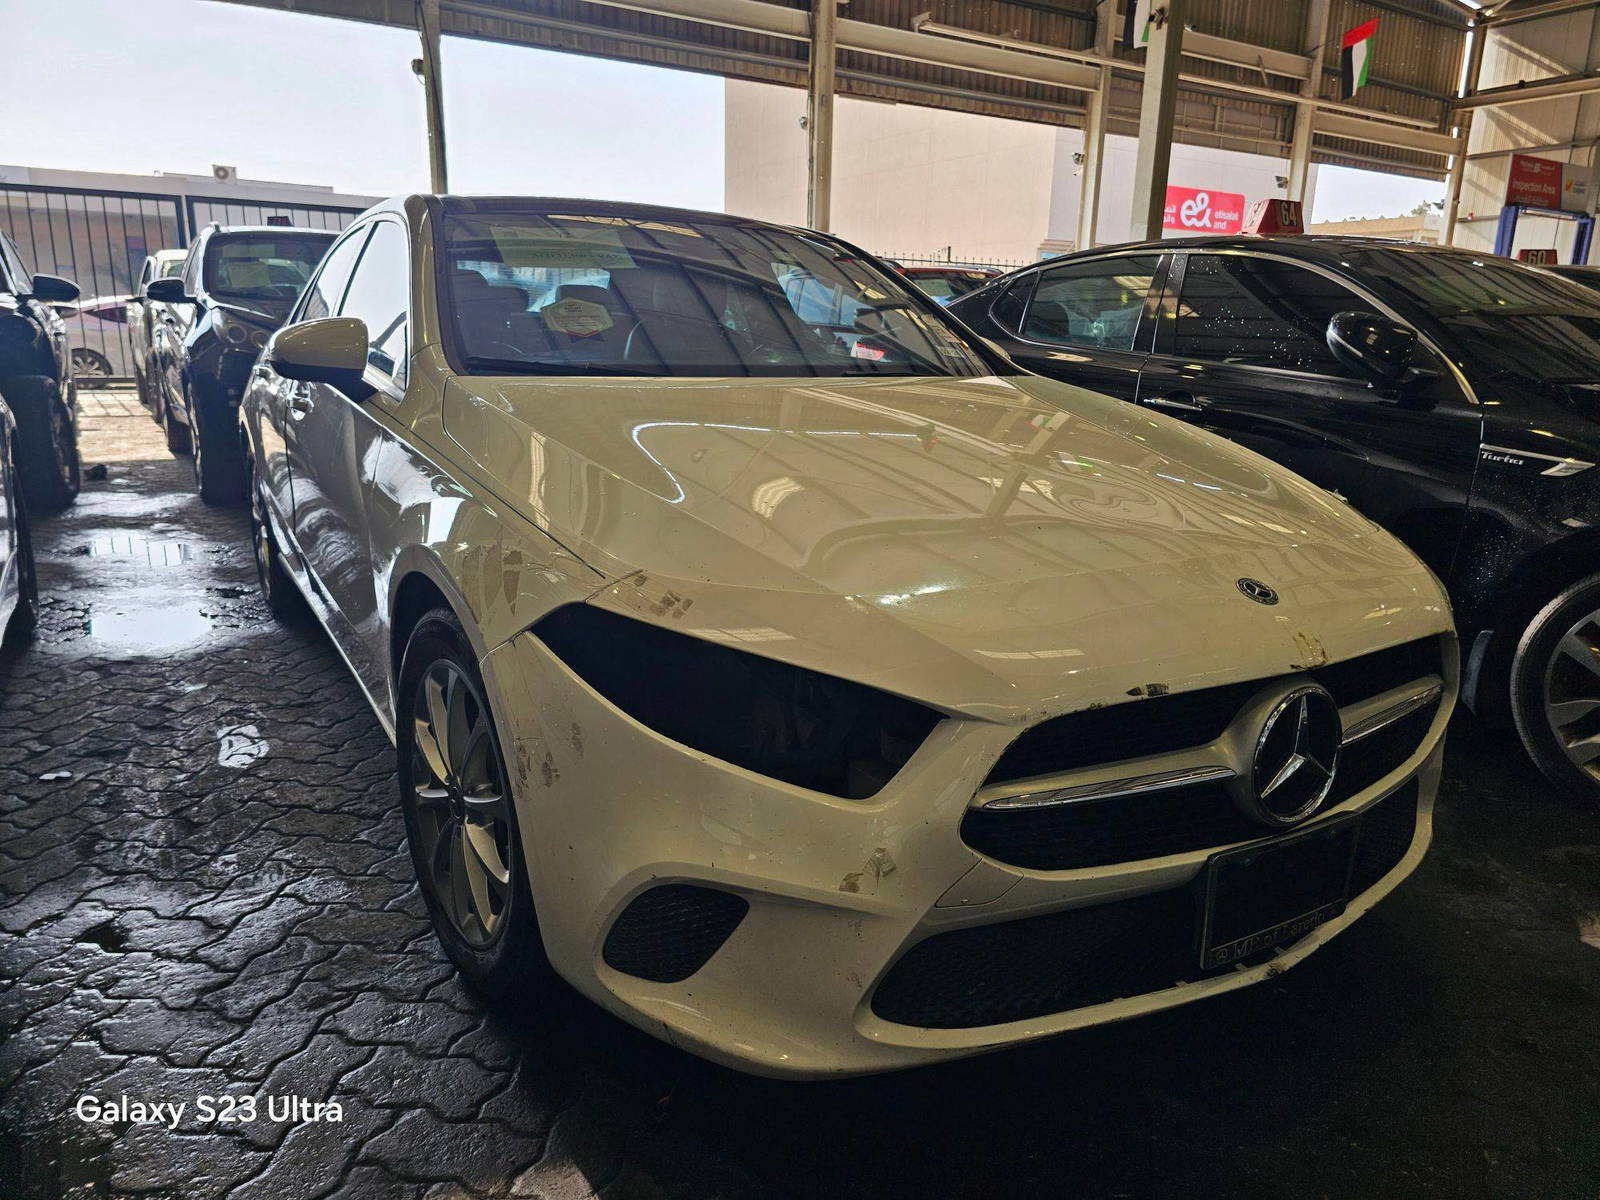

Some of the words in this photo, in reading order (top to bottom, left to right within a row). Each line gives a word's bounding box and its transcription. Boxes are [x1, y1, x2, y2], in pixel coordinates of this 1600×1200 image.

[1215, 210, 1239, 220] etisalat
[1281, 201, 1297, 226] 64
[1213, 221, 1227, 229] and
[1528, 250, 1546, 265] 60
